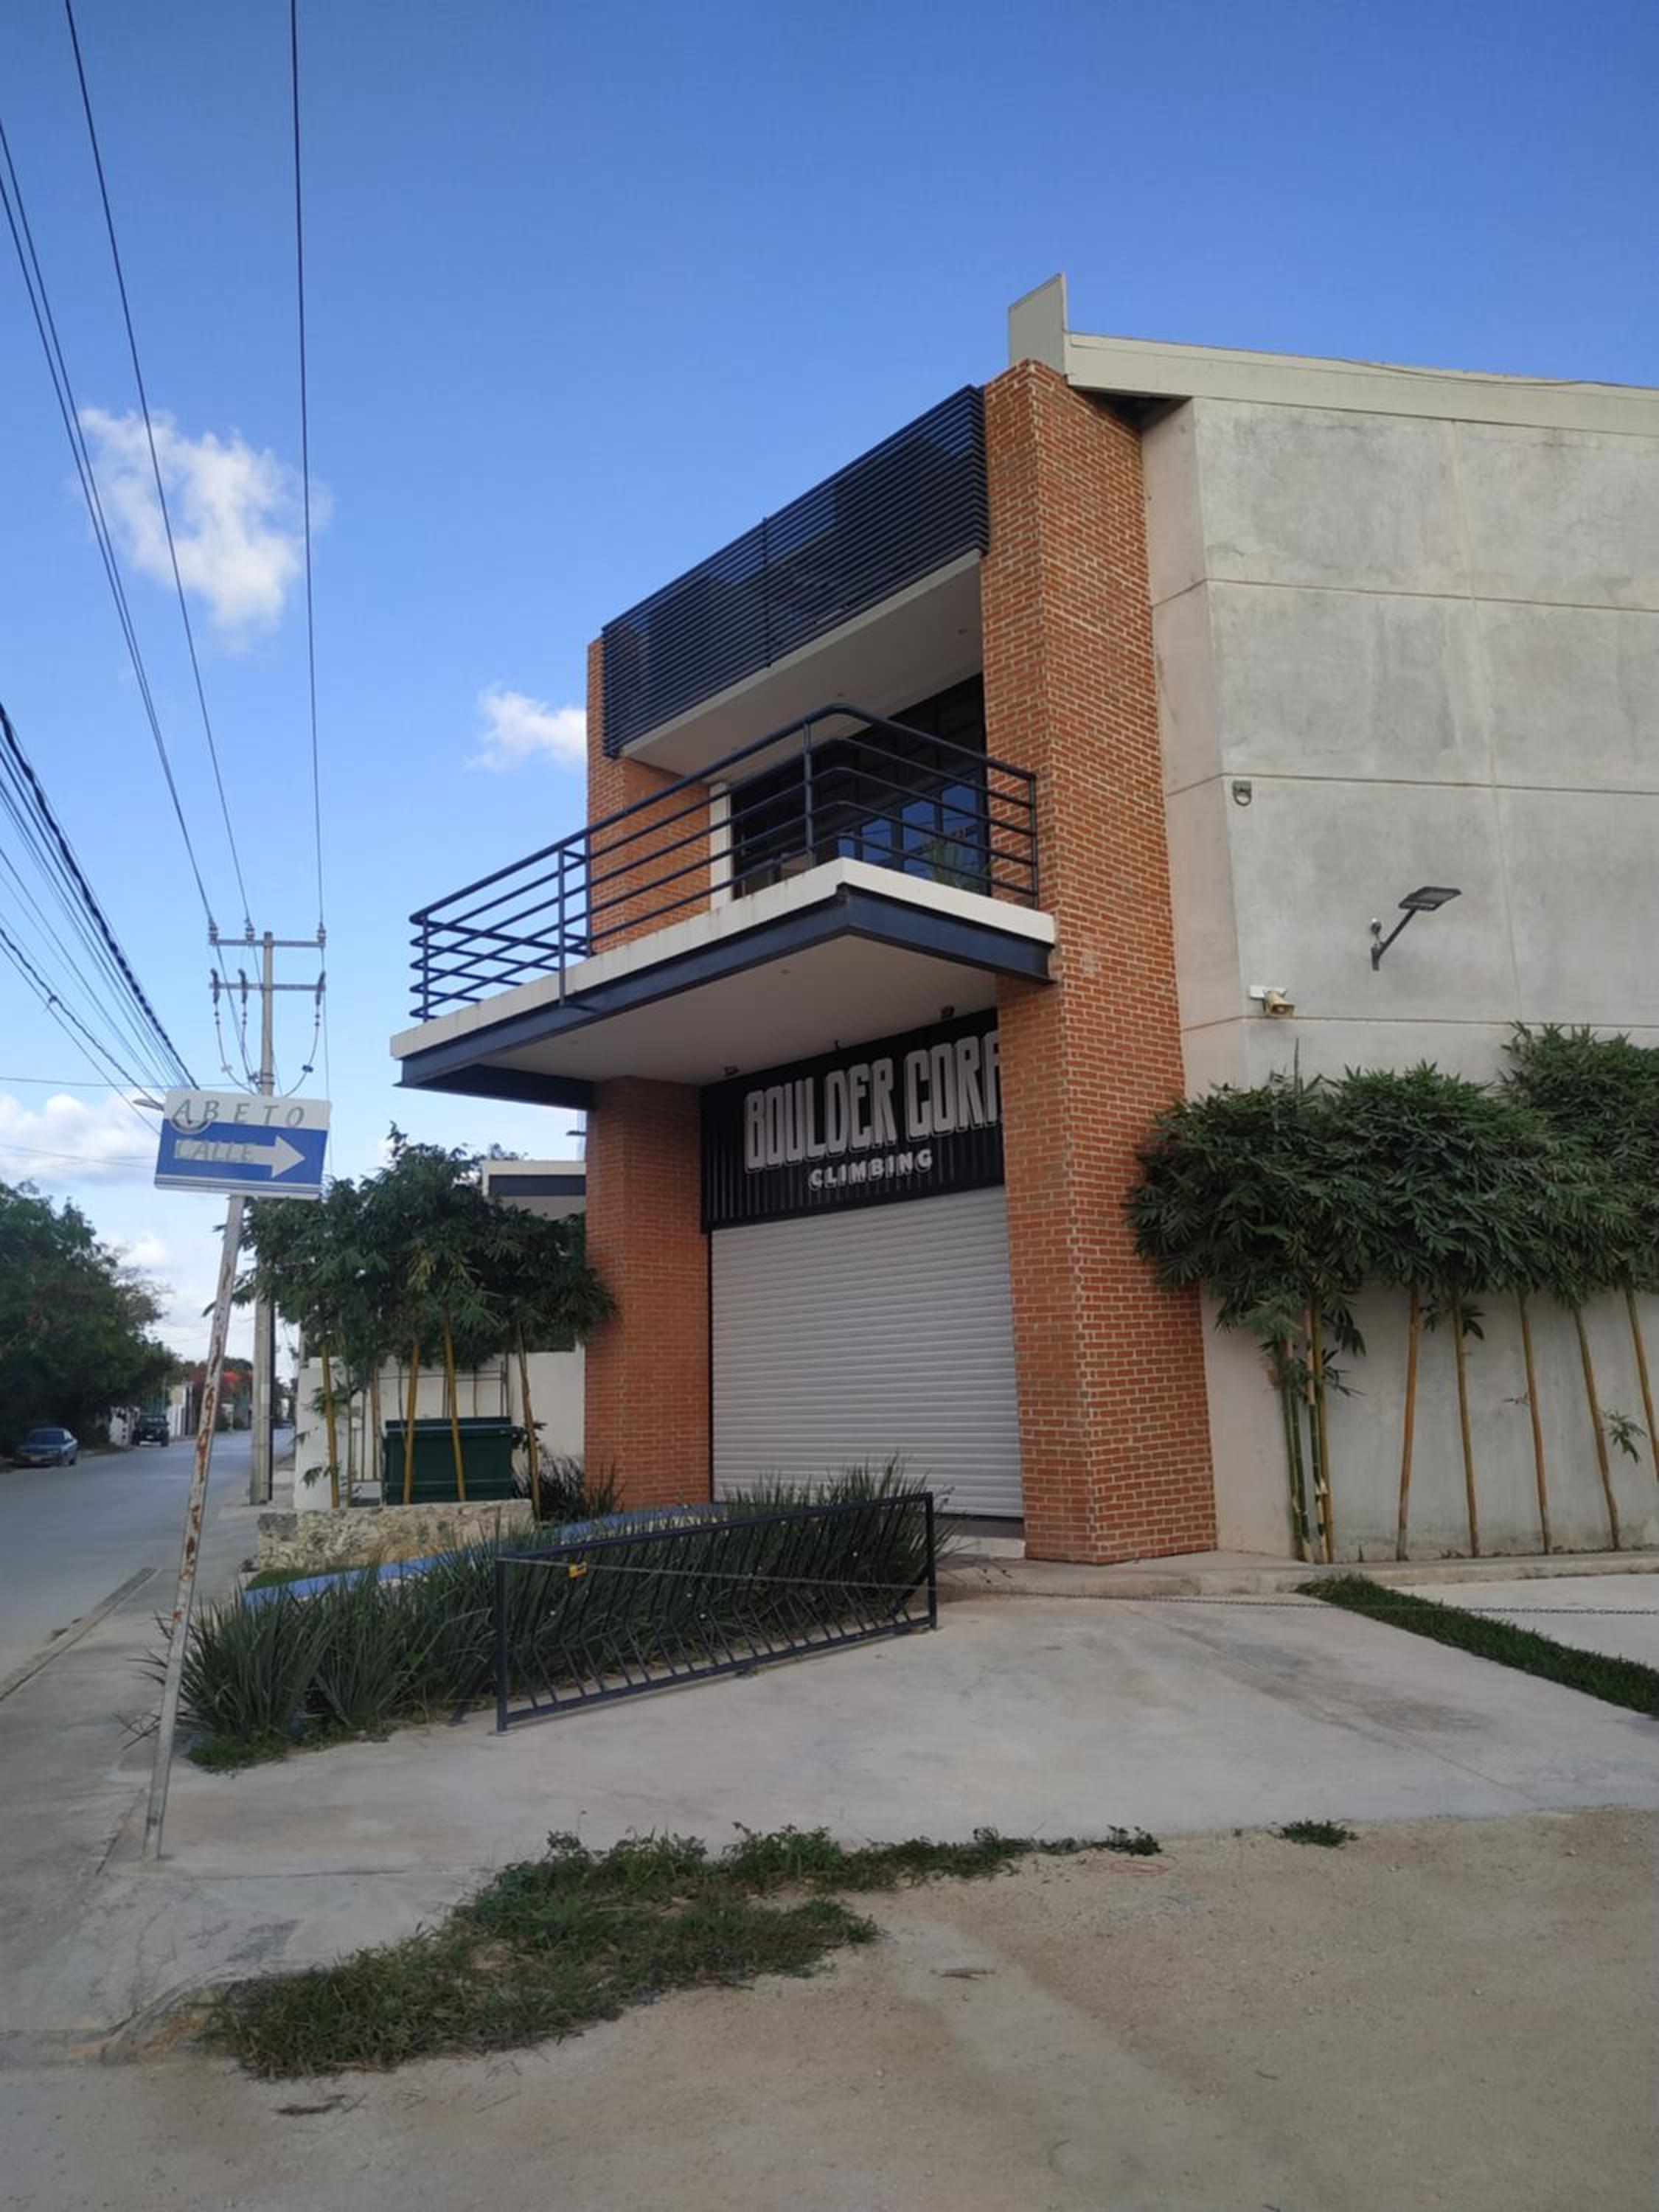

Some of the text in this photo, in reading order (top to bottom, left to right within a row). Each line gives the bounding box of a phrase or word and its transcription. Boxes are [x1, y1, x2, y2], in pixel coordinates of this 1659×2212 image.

[172, 1099, 305, 1127] ABETO
[745, 1058, 897, 1173] BOULDER
[175, 1141, 254, 1162] CALLE
[808, 1150, 933, 1191] CLIMBING
